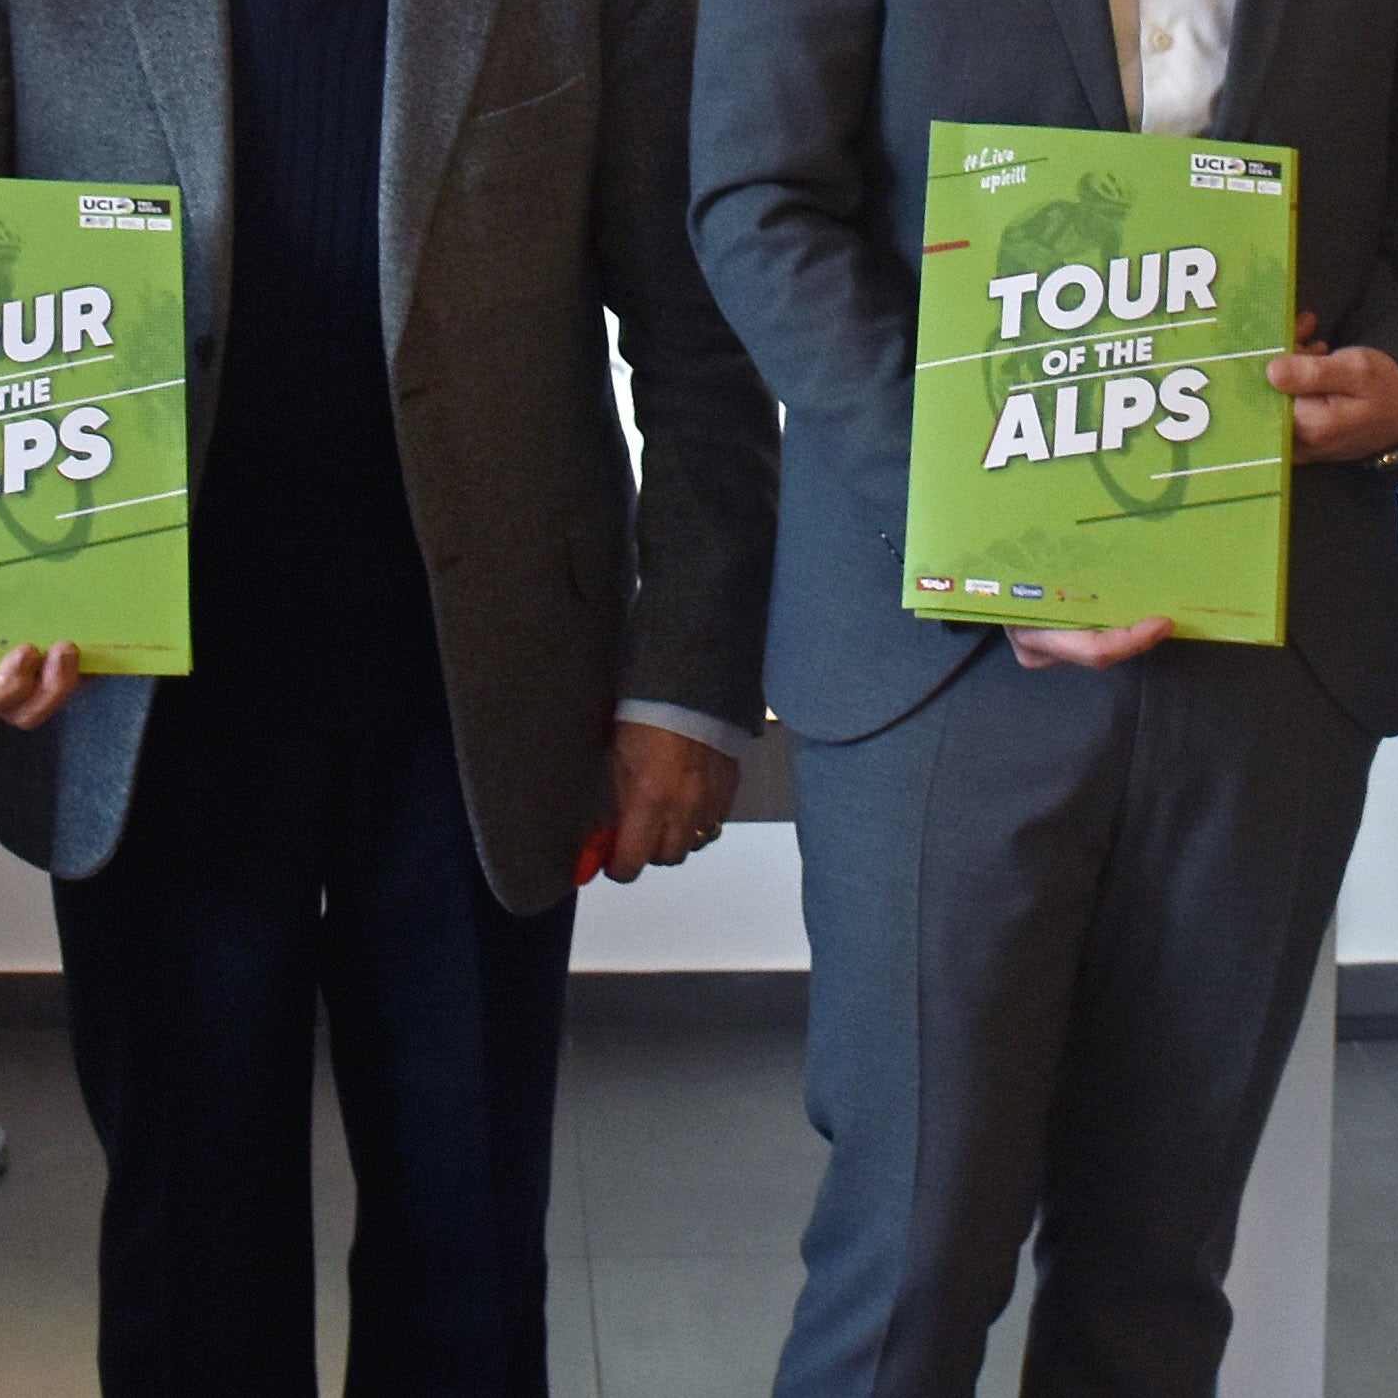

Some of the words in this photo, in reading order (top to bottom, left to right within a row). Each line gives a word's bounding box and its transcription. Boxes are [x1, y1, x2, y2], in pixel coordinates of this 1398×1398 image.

[1194, 157, 1225, 171] UCI
[83, 199, 114, 211] UCI
[988, 245, 1219, 341] TOUR
[1042, 342, 1086, 376] OF
[1094, 335, 1155, 370] THE
[982, 366, 1212, 470] ALPS
